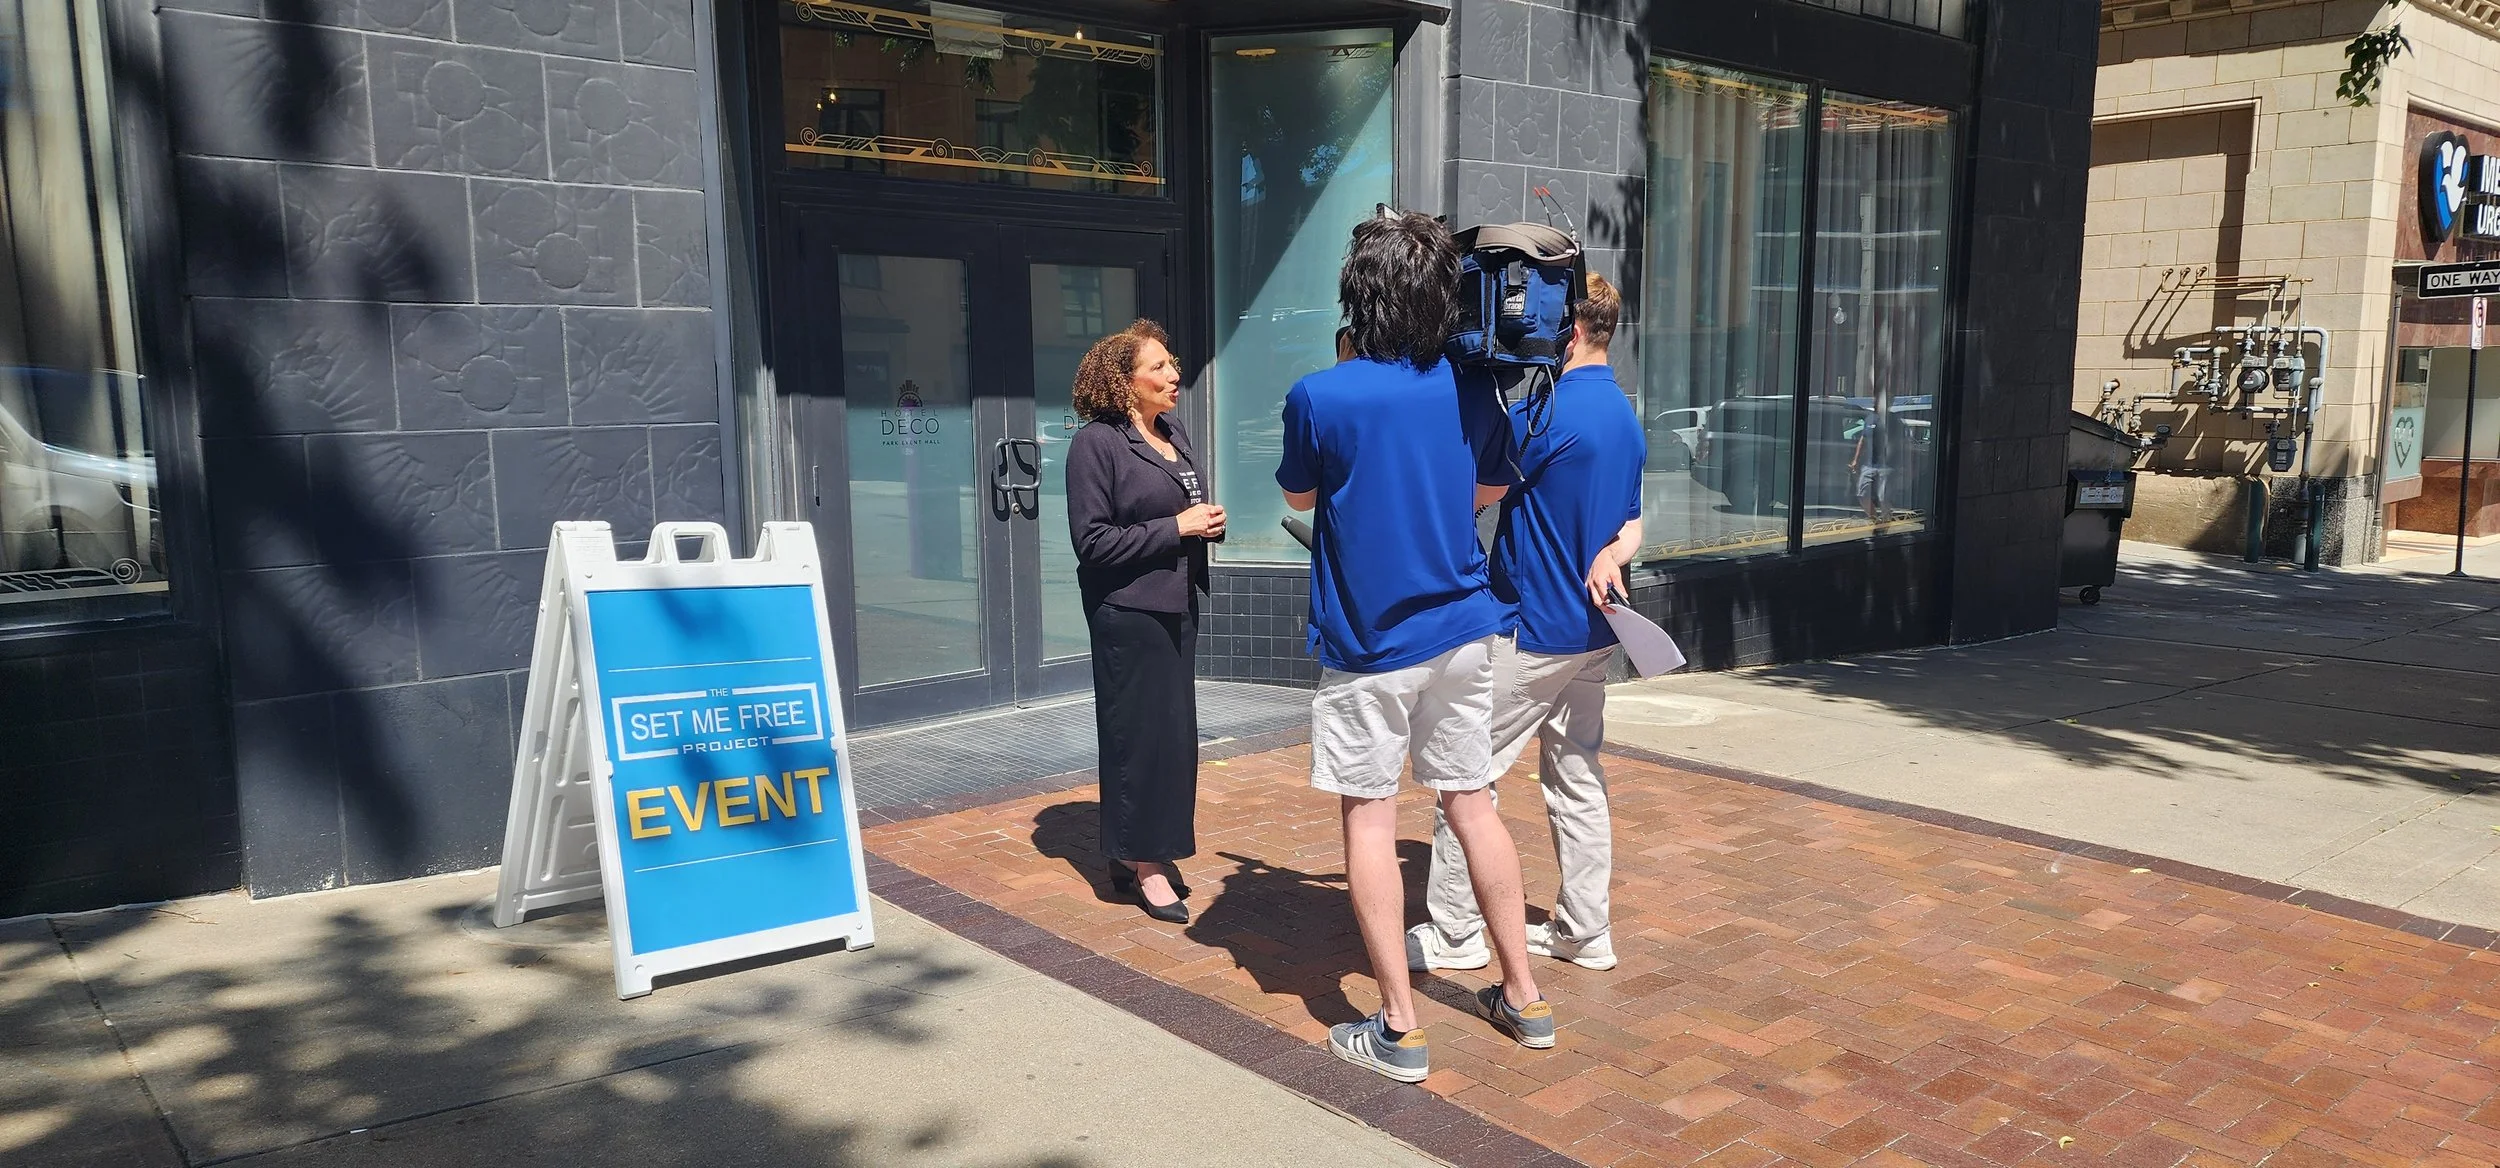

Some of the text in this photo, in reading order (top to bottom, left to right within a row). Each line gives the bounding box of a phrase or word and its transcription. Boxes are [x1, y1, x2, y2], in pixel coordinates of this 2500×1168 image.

[2477, 203, 2500, 236] URG
[2431, 270, 2500, 288] ONE WAY
[881, 409, 938, 417] HOTEL
[881, 418, 940, 436] DECO
[709, 687, 728, 697] THE
[631, 700, 806, 741] SET ME FREE
[682, 736, 769, 754] PROJECT
[626, 767, 830, 840] EVENT
